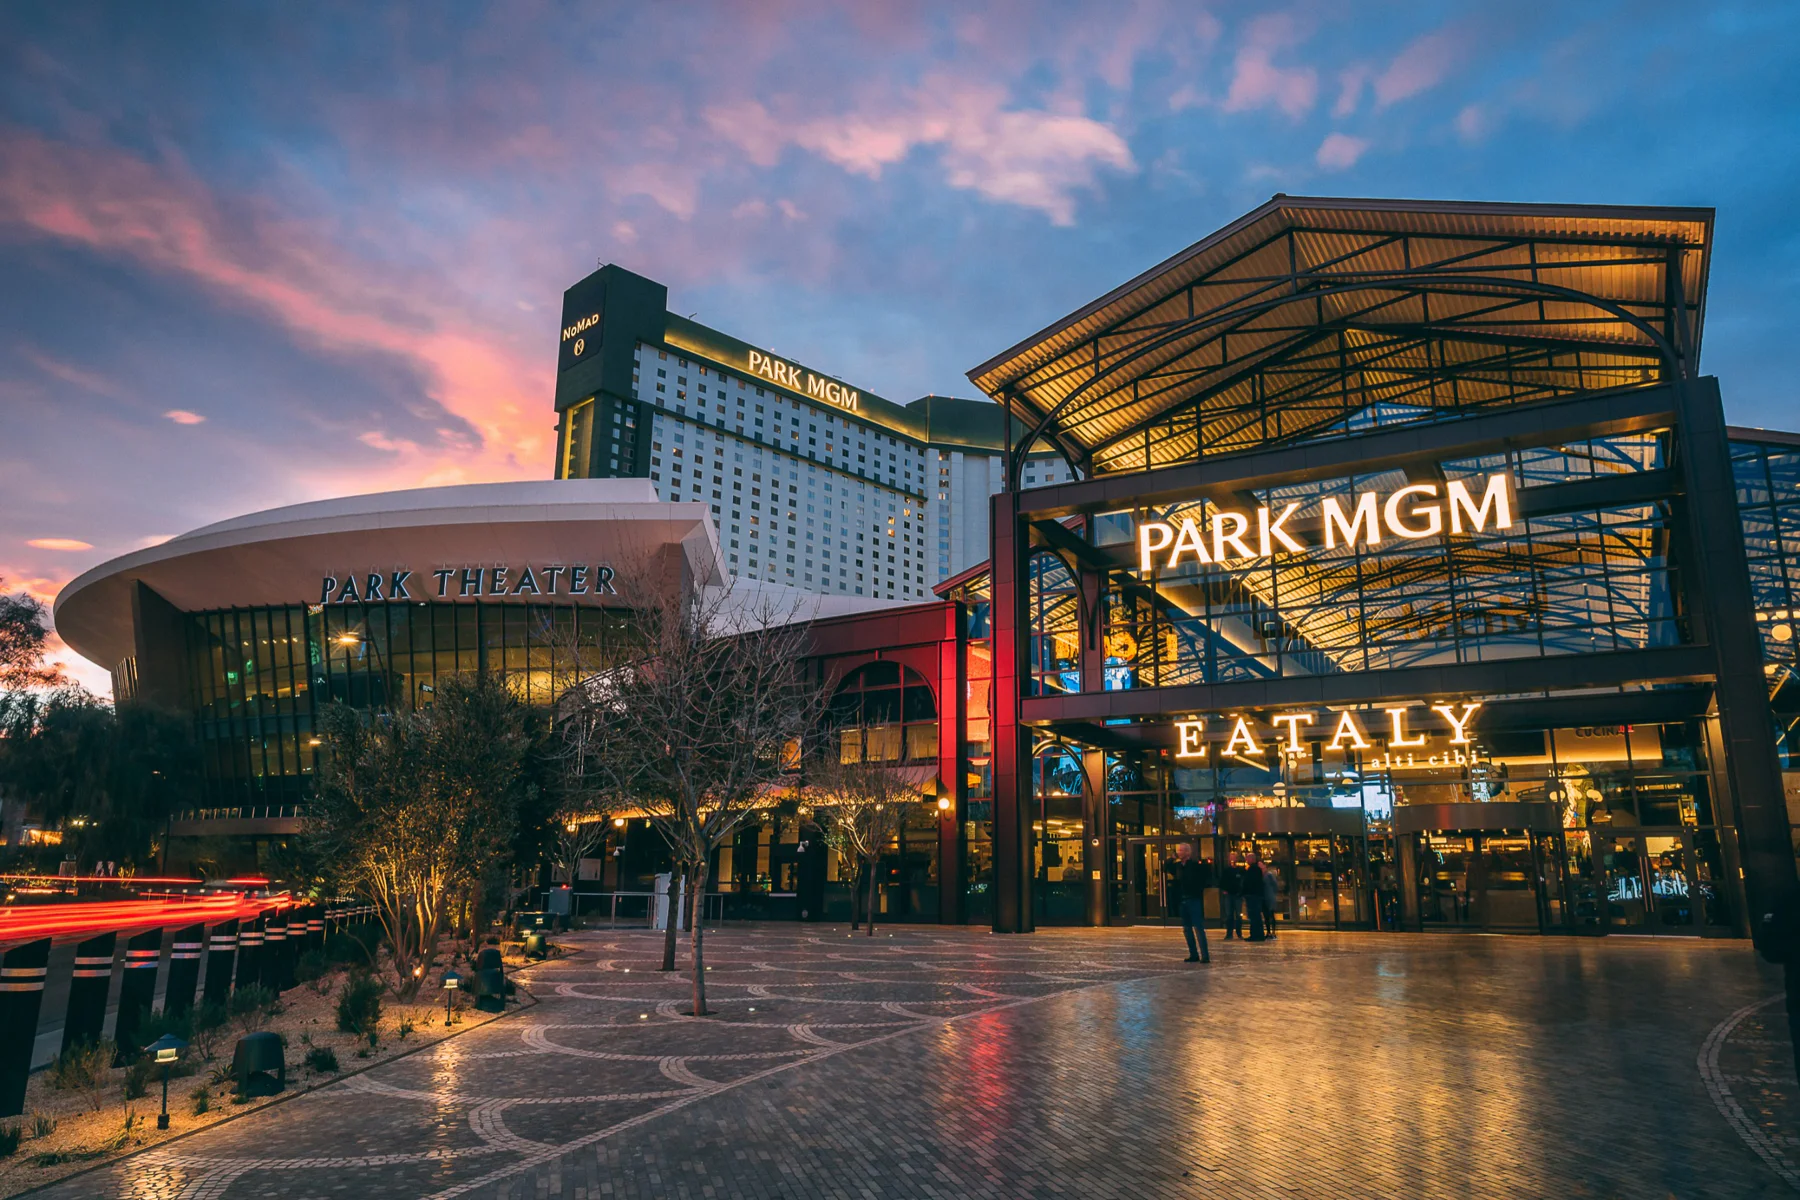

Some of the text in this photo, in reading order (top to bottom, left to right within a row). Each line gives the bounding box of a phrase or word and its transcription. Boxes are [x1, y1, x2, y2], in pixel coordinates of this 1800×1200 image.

[748, 350, 858, 411] PARK MGM
[1138, 473, 1513, 572] PARK MGM
[321, 565, 617, 605] PARK THEATER
[1174, 702, 1482, 758] EATALY
[1371, 749, 1479, 768] alti cibi
